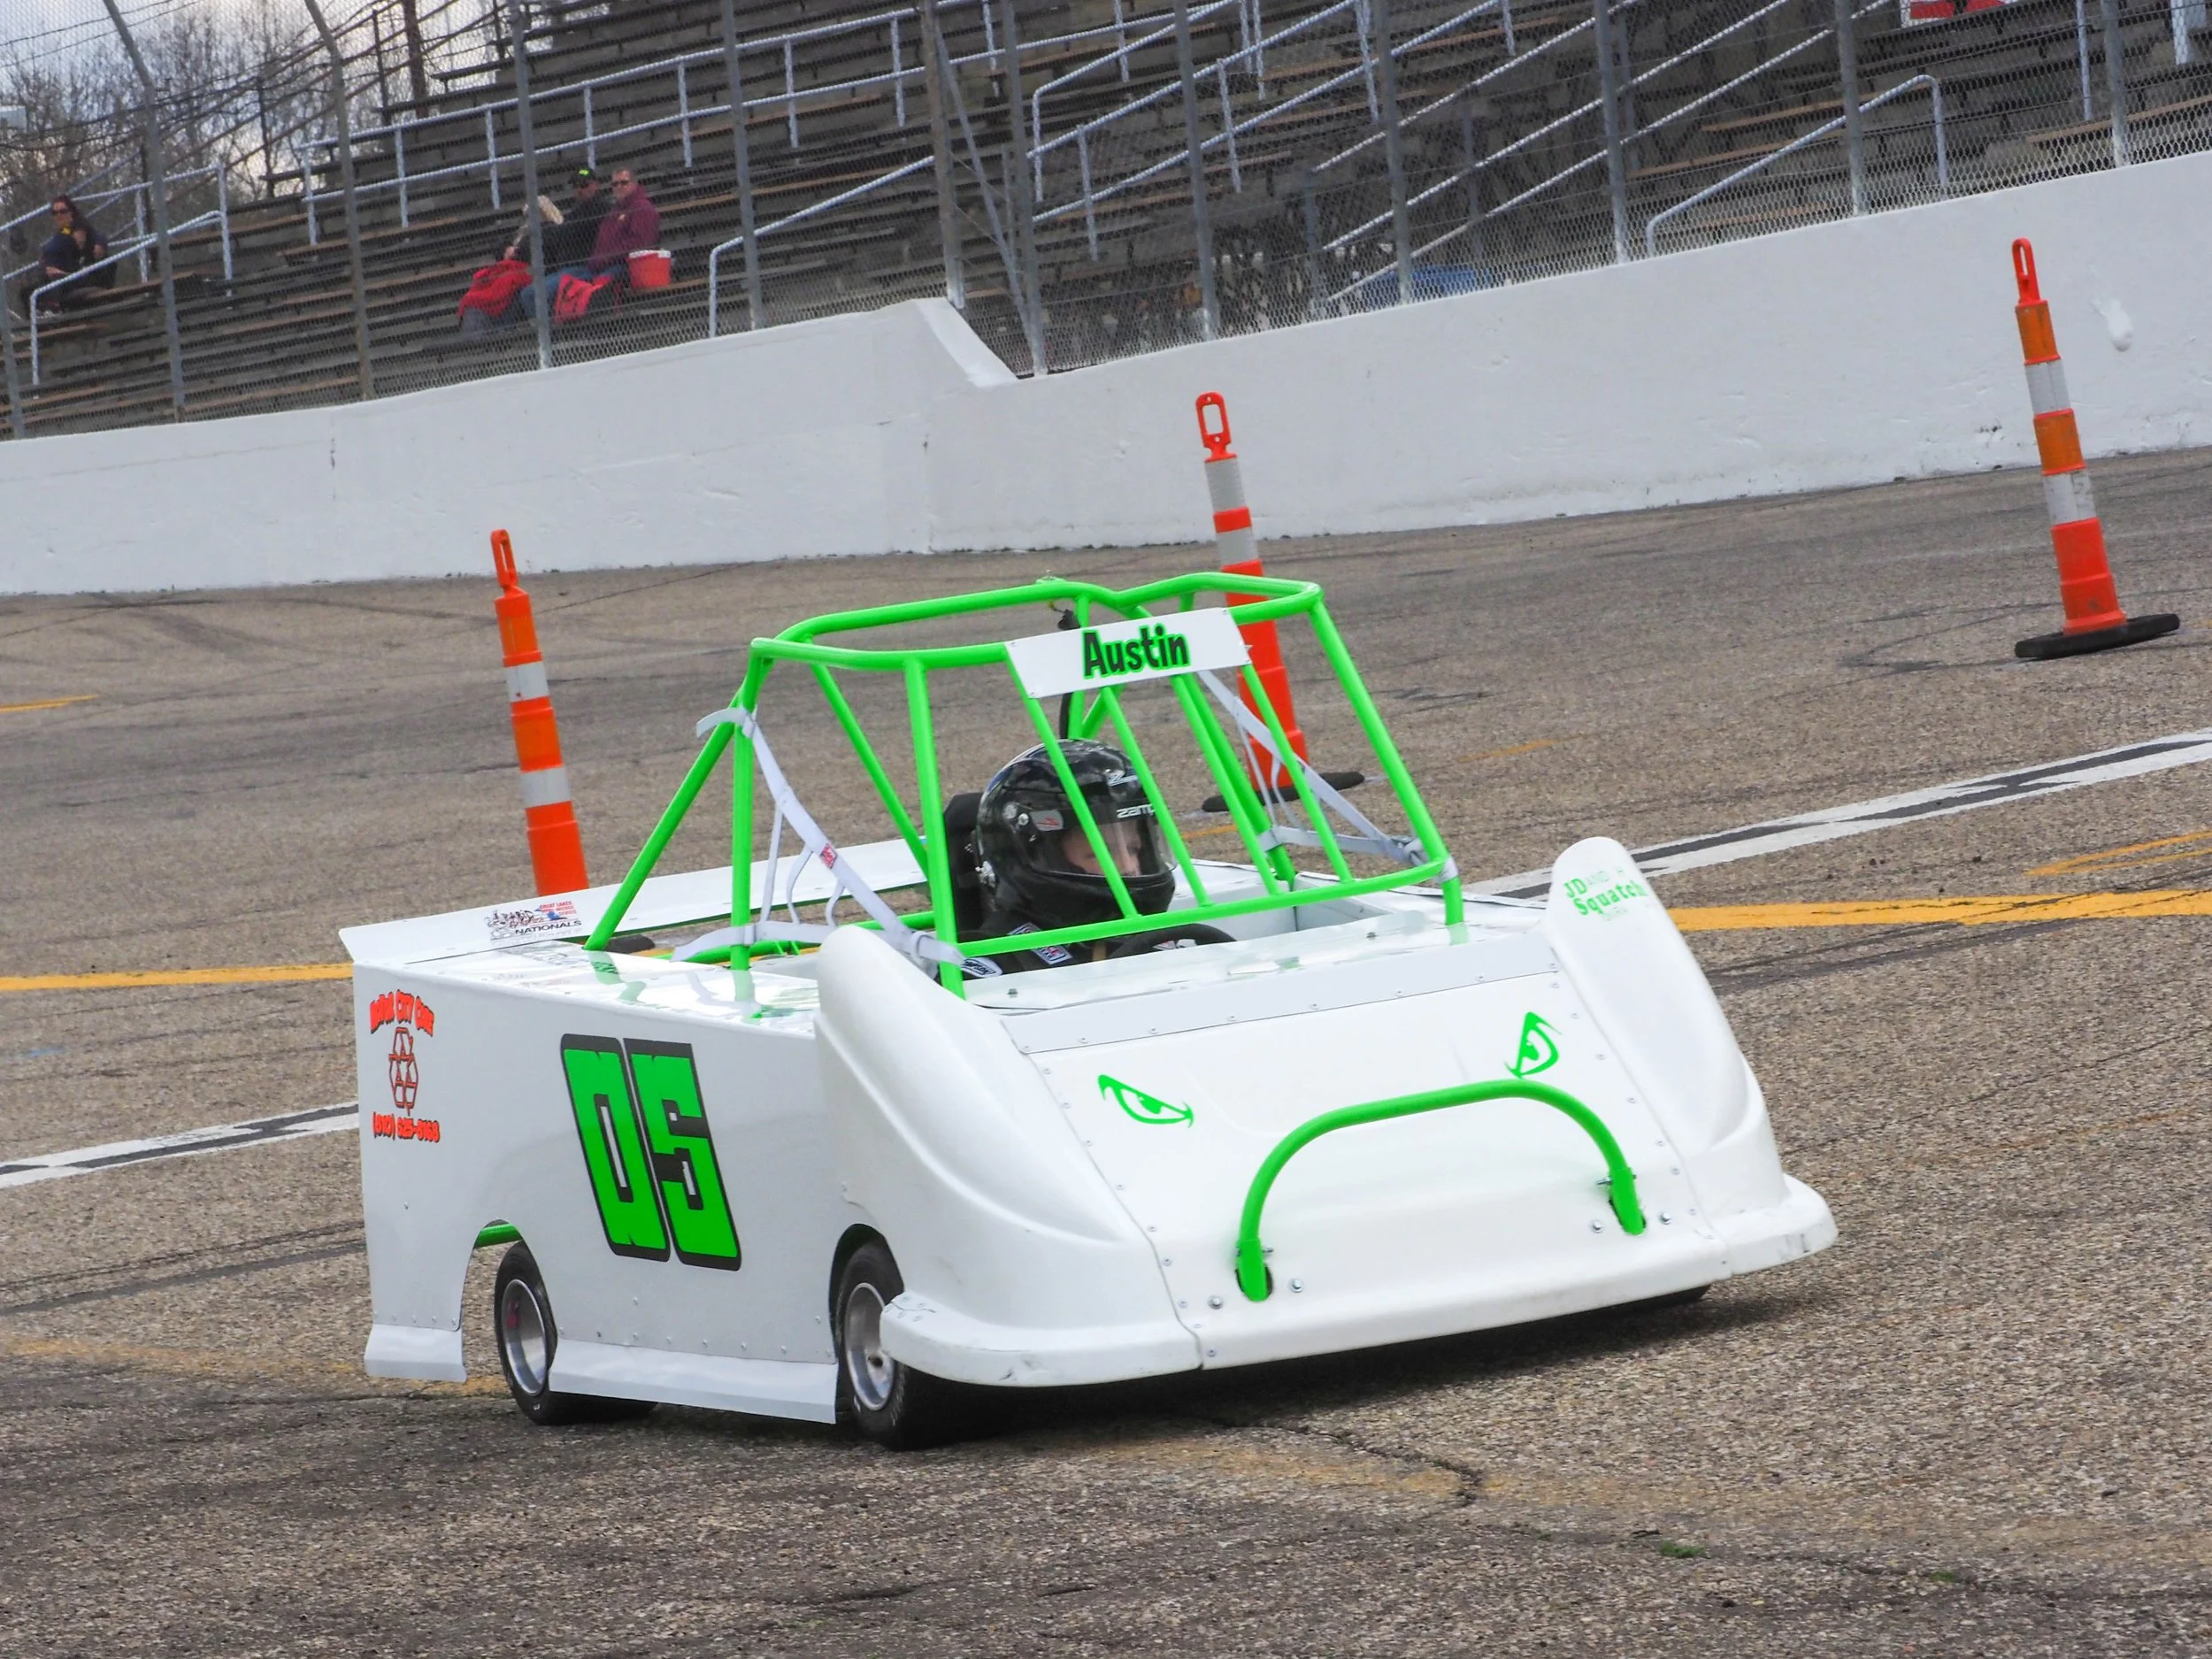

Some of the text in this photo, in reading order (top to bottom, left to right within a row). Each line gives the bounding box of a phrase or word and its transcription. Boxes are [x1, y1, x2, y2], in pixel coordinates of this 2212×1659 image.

[1083, 623, 1190, 679] Austin
[1563, 878, 1587, 898] JD
[1573, 879, 1649, 916] Squatch
[515, 920, 582, 934] NATIONALS
[396, 988, 415, 1025] CITY
[560, 1033, 741, 1271] 05
